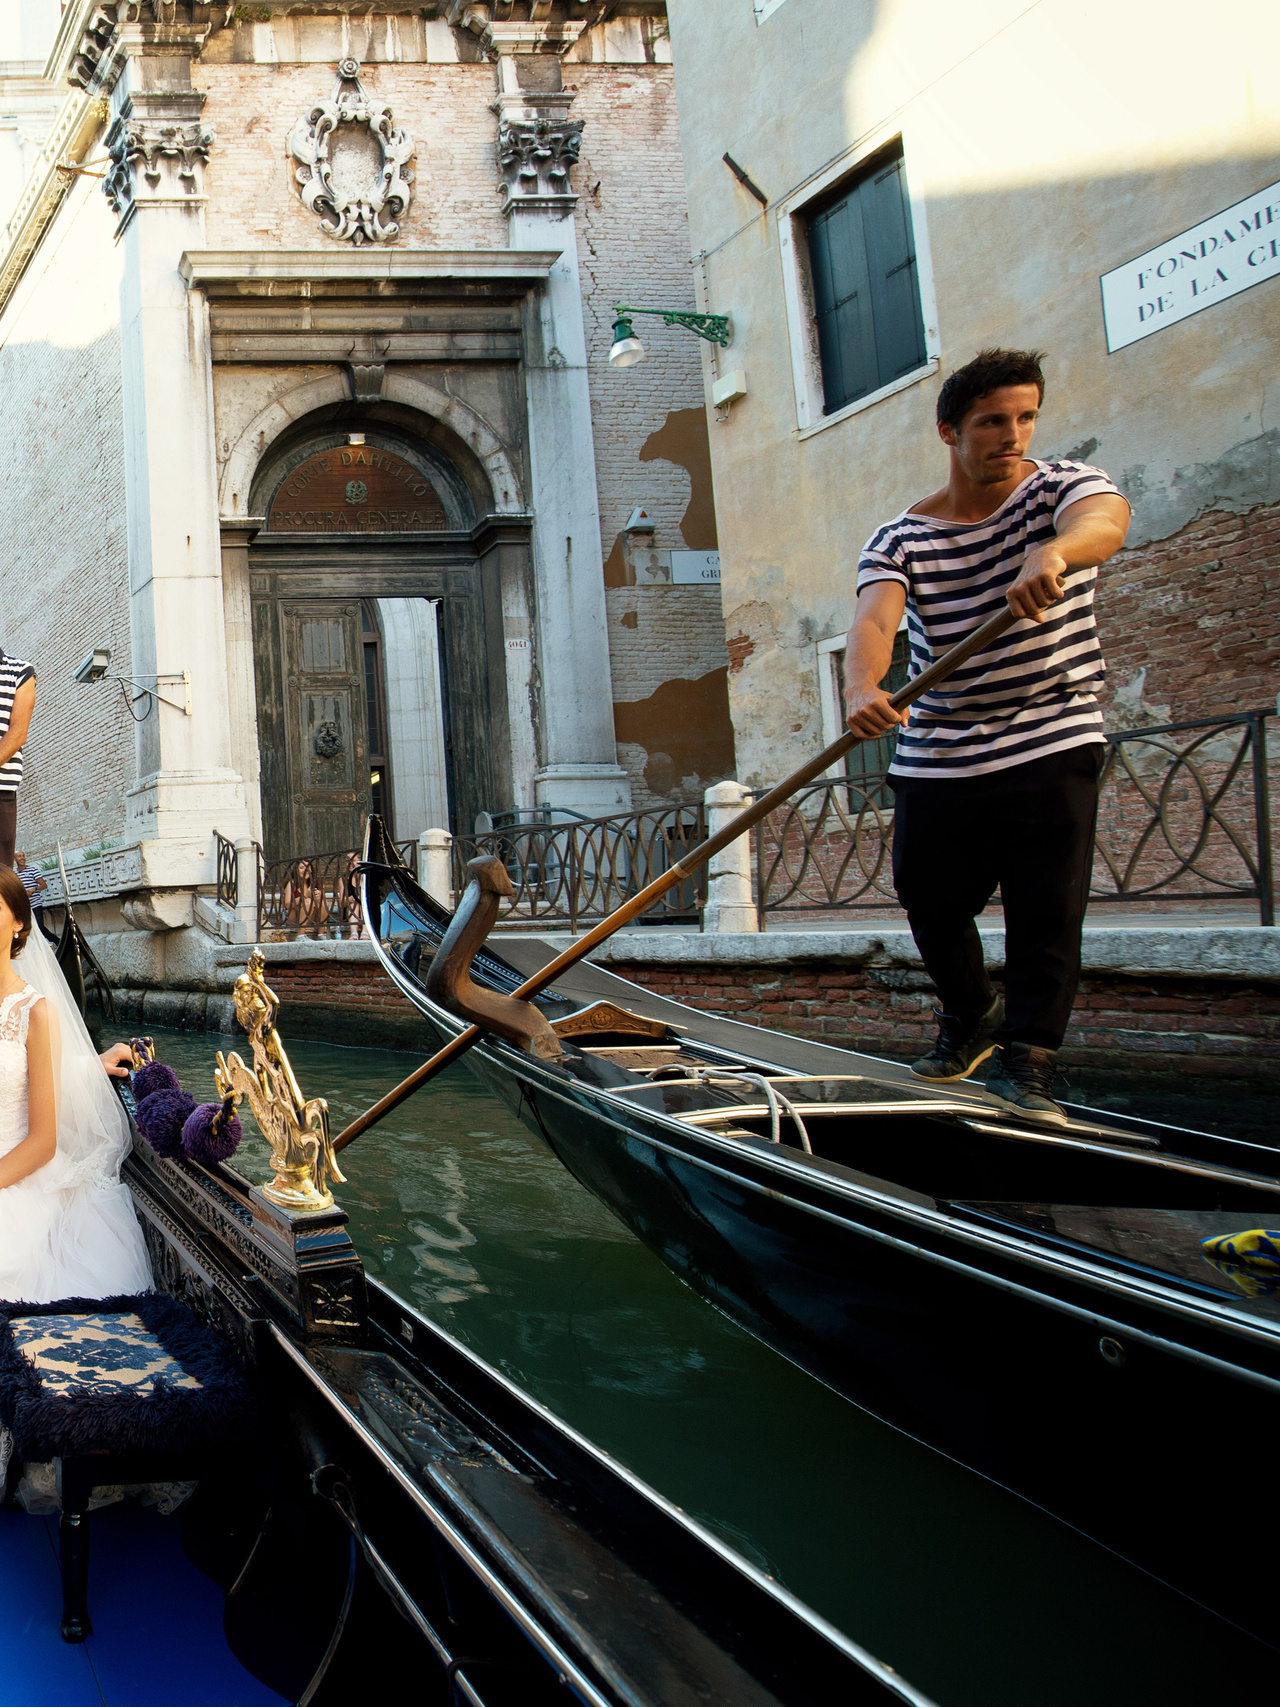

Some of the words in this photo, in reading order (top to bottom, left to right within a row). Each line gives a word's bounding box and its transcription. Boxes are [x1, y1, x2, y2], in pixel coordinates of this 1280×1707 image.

[1138, 200, 1280, 290] FONDAME
[1138, 291, 1174, 322] DE
[1191, 268, 1229, 297] LA
[286, 458, 333, 498] CORTE
[273, 511, 348, 525] PROCURA
[357, 510, 444, 524] GENERALE
